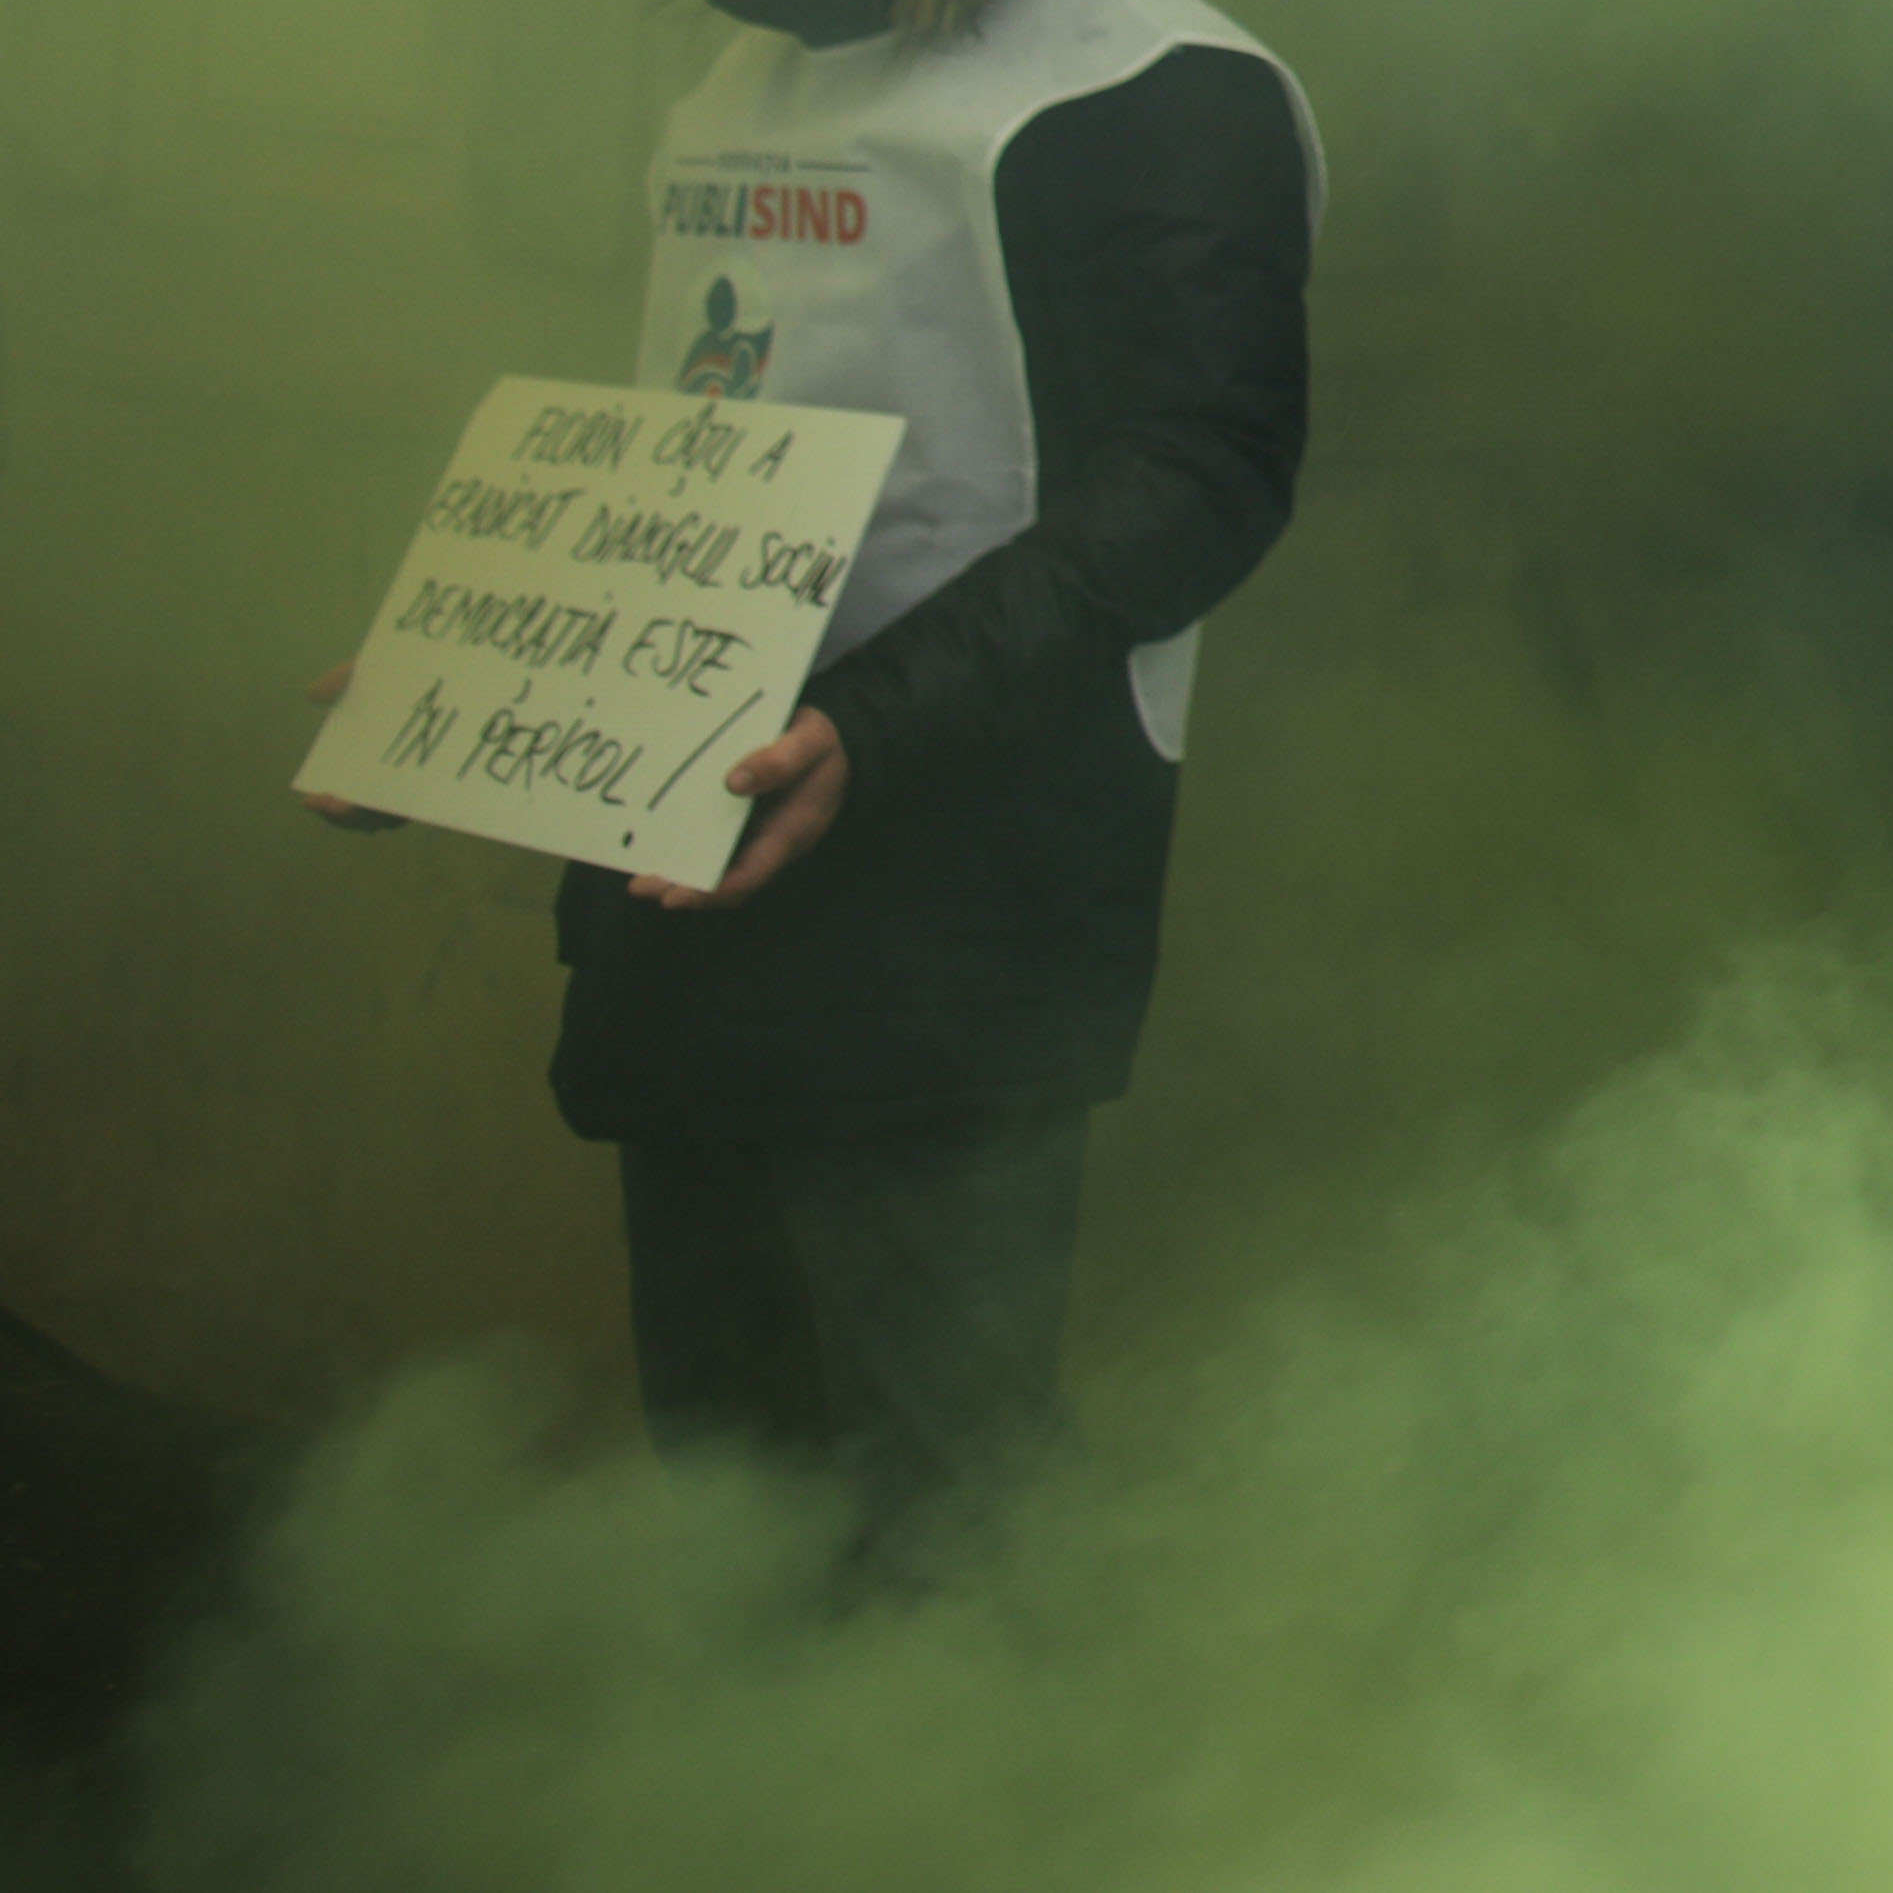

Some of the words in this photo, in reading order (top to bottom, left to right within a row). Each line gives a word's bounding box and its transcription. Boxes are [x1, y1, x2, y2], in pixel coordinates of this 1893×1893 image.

[658, 180, 869, 246] PUBLISIND
[748, 430, 796, 484] A
[623, 616, 754, 699] ESTE
